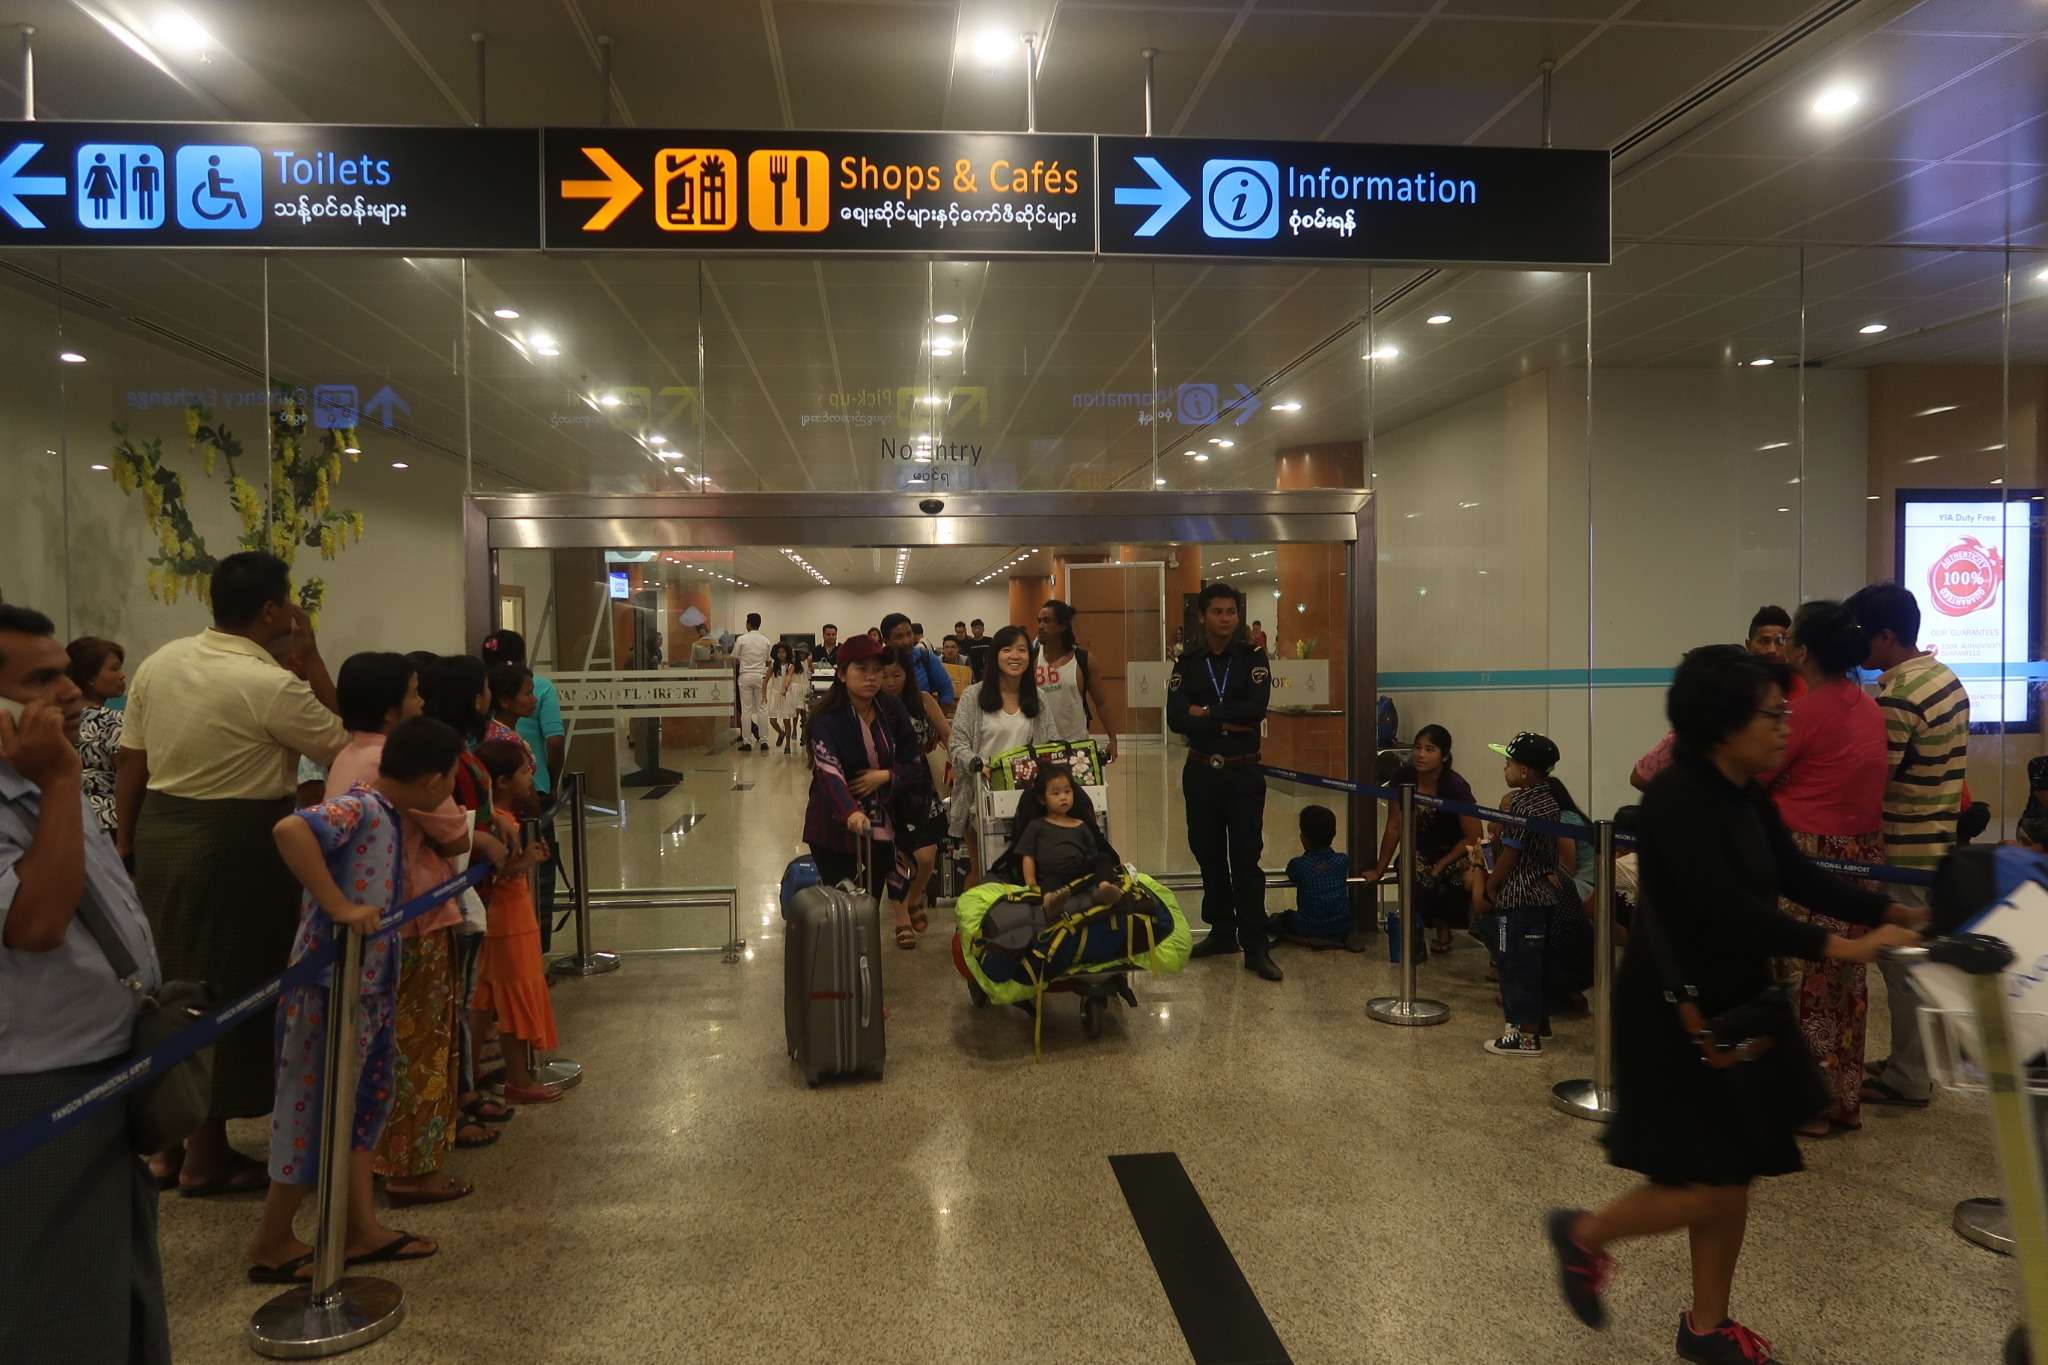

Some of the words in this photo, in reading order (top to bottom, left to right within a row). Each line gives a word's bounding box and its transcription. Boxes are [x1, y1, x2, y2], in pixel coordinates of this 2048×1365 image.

[273, 151, 391, 185] Toilets
[840, 156, 942, 200] Shops
[953, 158, 978, 193] &
[990, 159, 1078, 194] Cafés
[1289, 166, 1477, 204] Information
[881, 438, 912, 460] No
[922, 440, 982, 466] Entry
[1955, 513, 1975, 524] Duty
[1977, 513, 1997, 521] Free
[1944, 570, 1984, 586] 100%
